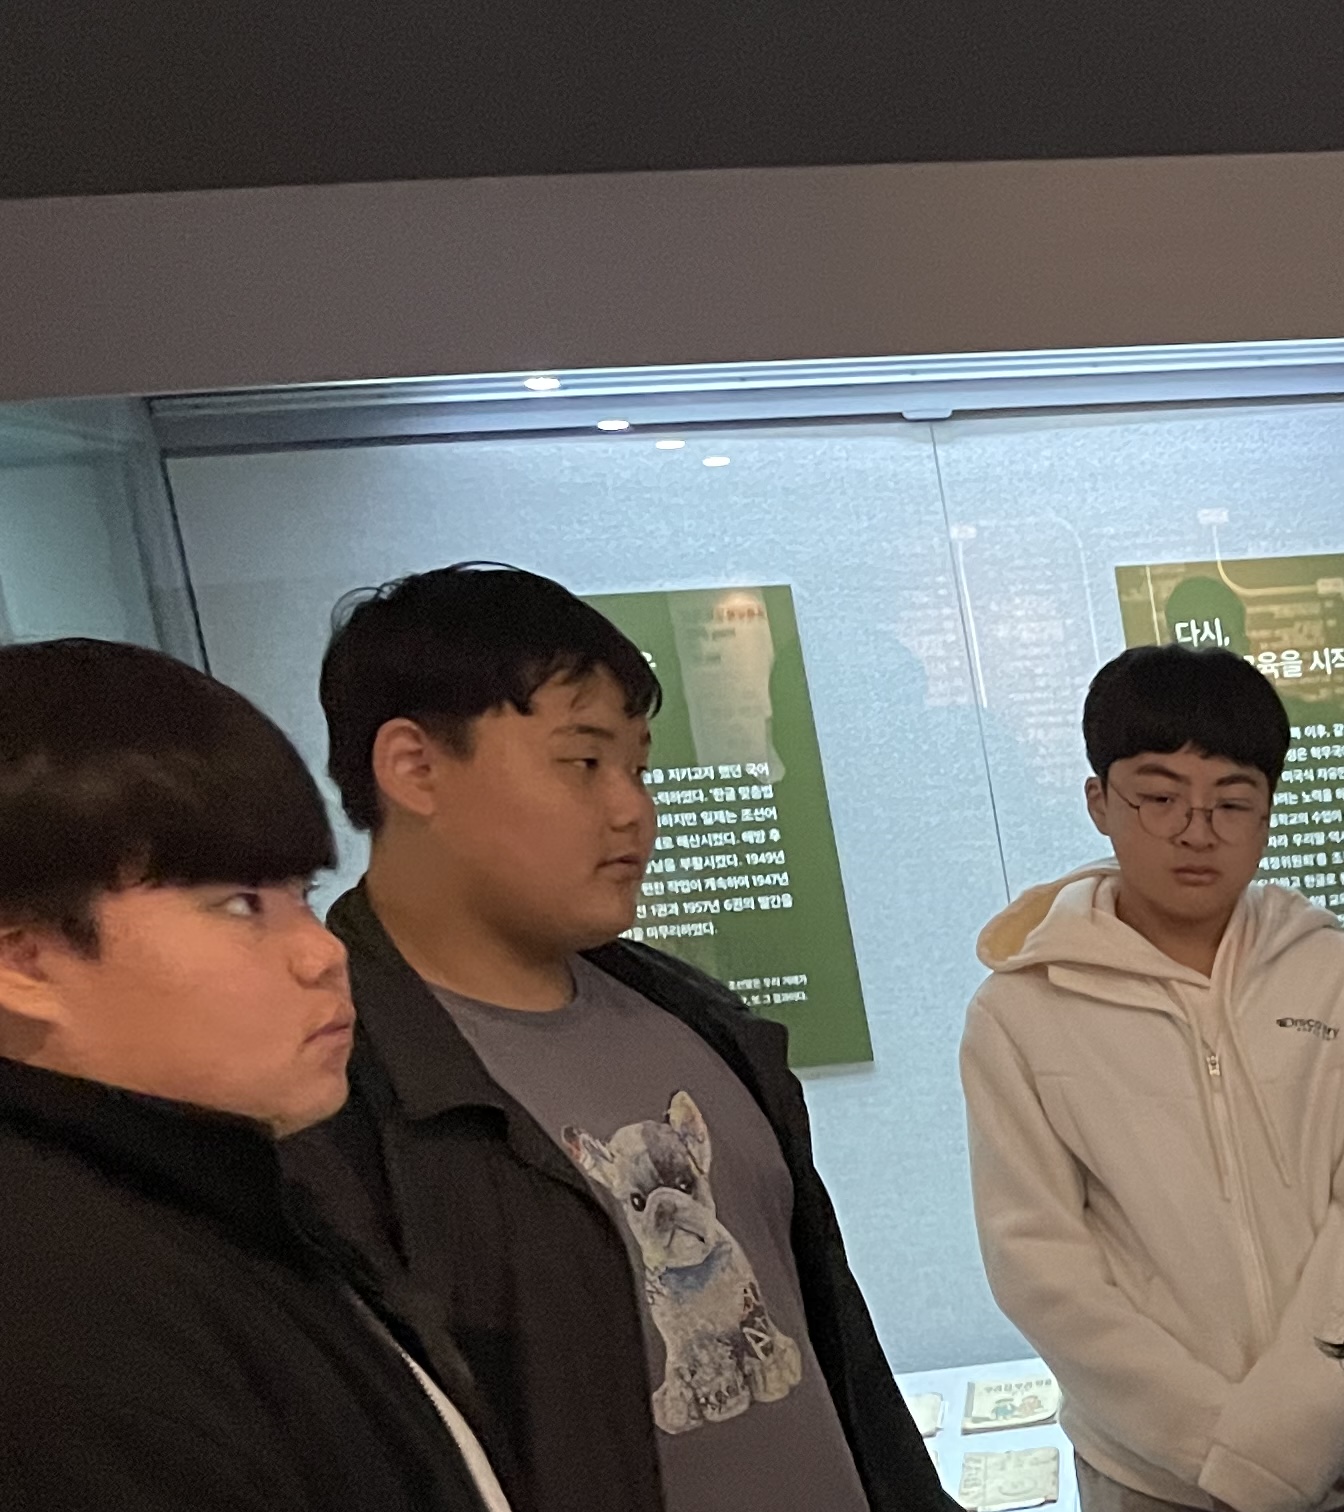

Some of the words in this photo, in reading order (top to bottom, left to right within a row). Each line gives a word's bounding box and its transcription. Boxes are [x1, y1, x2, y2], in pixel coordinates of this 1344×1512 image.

[1174, 617, 1231, 648] 다시,
[745, 762, 769, 777] 국어
[653, 788, 708, 806] 력하였다.
[657, 811, 697, 828] 하지만
[741, 806, 778, 822] 조선어
[745, 850, 785, 865] 1949년
[751, 871, 789, 887] 1947년
[682, 899, 720, 914] 1957년
